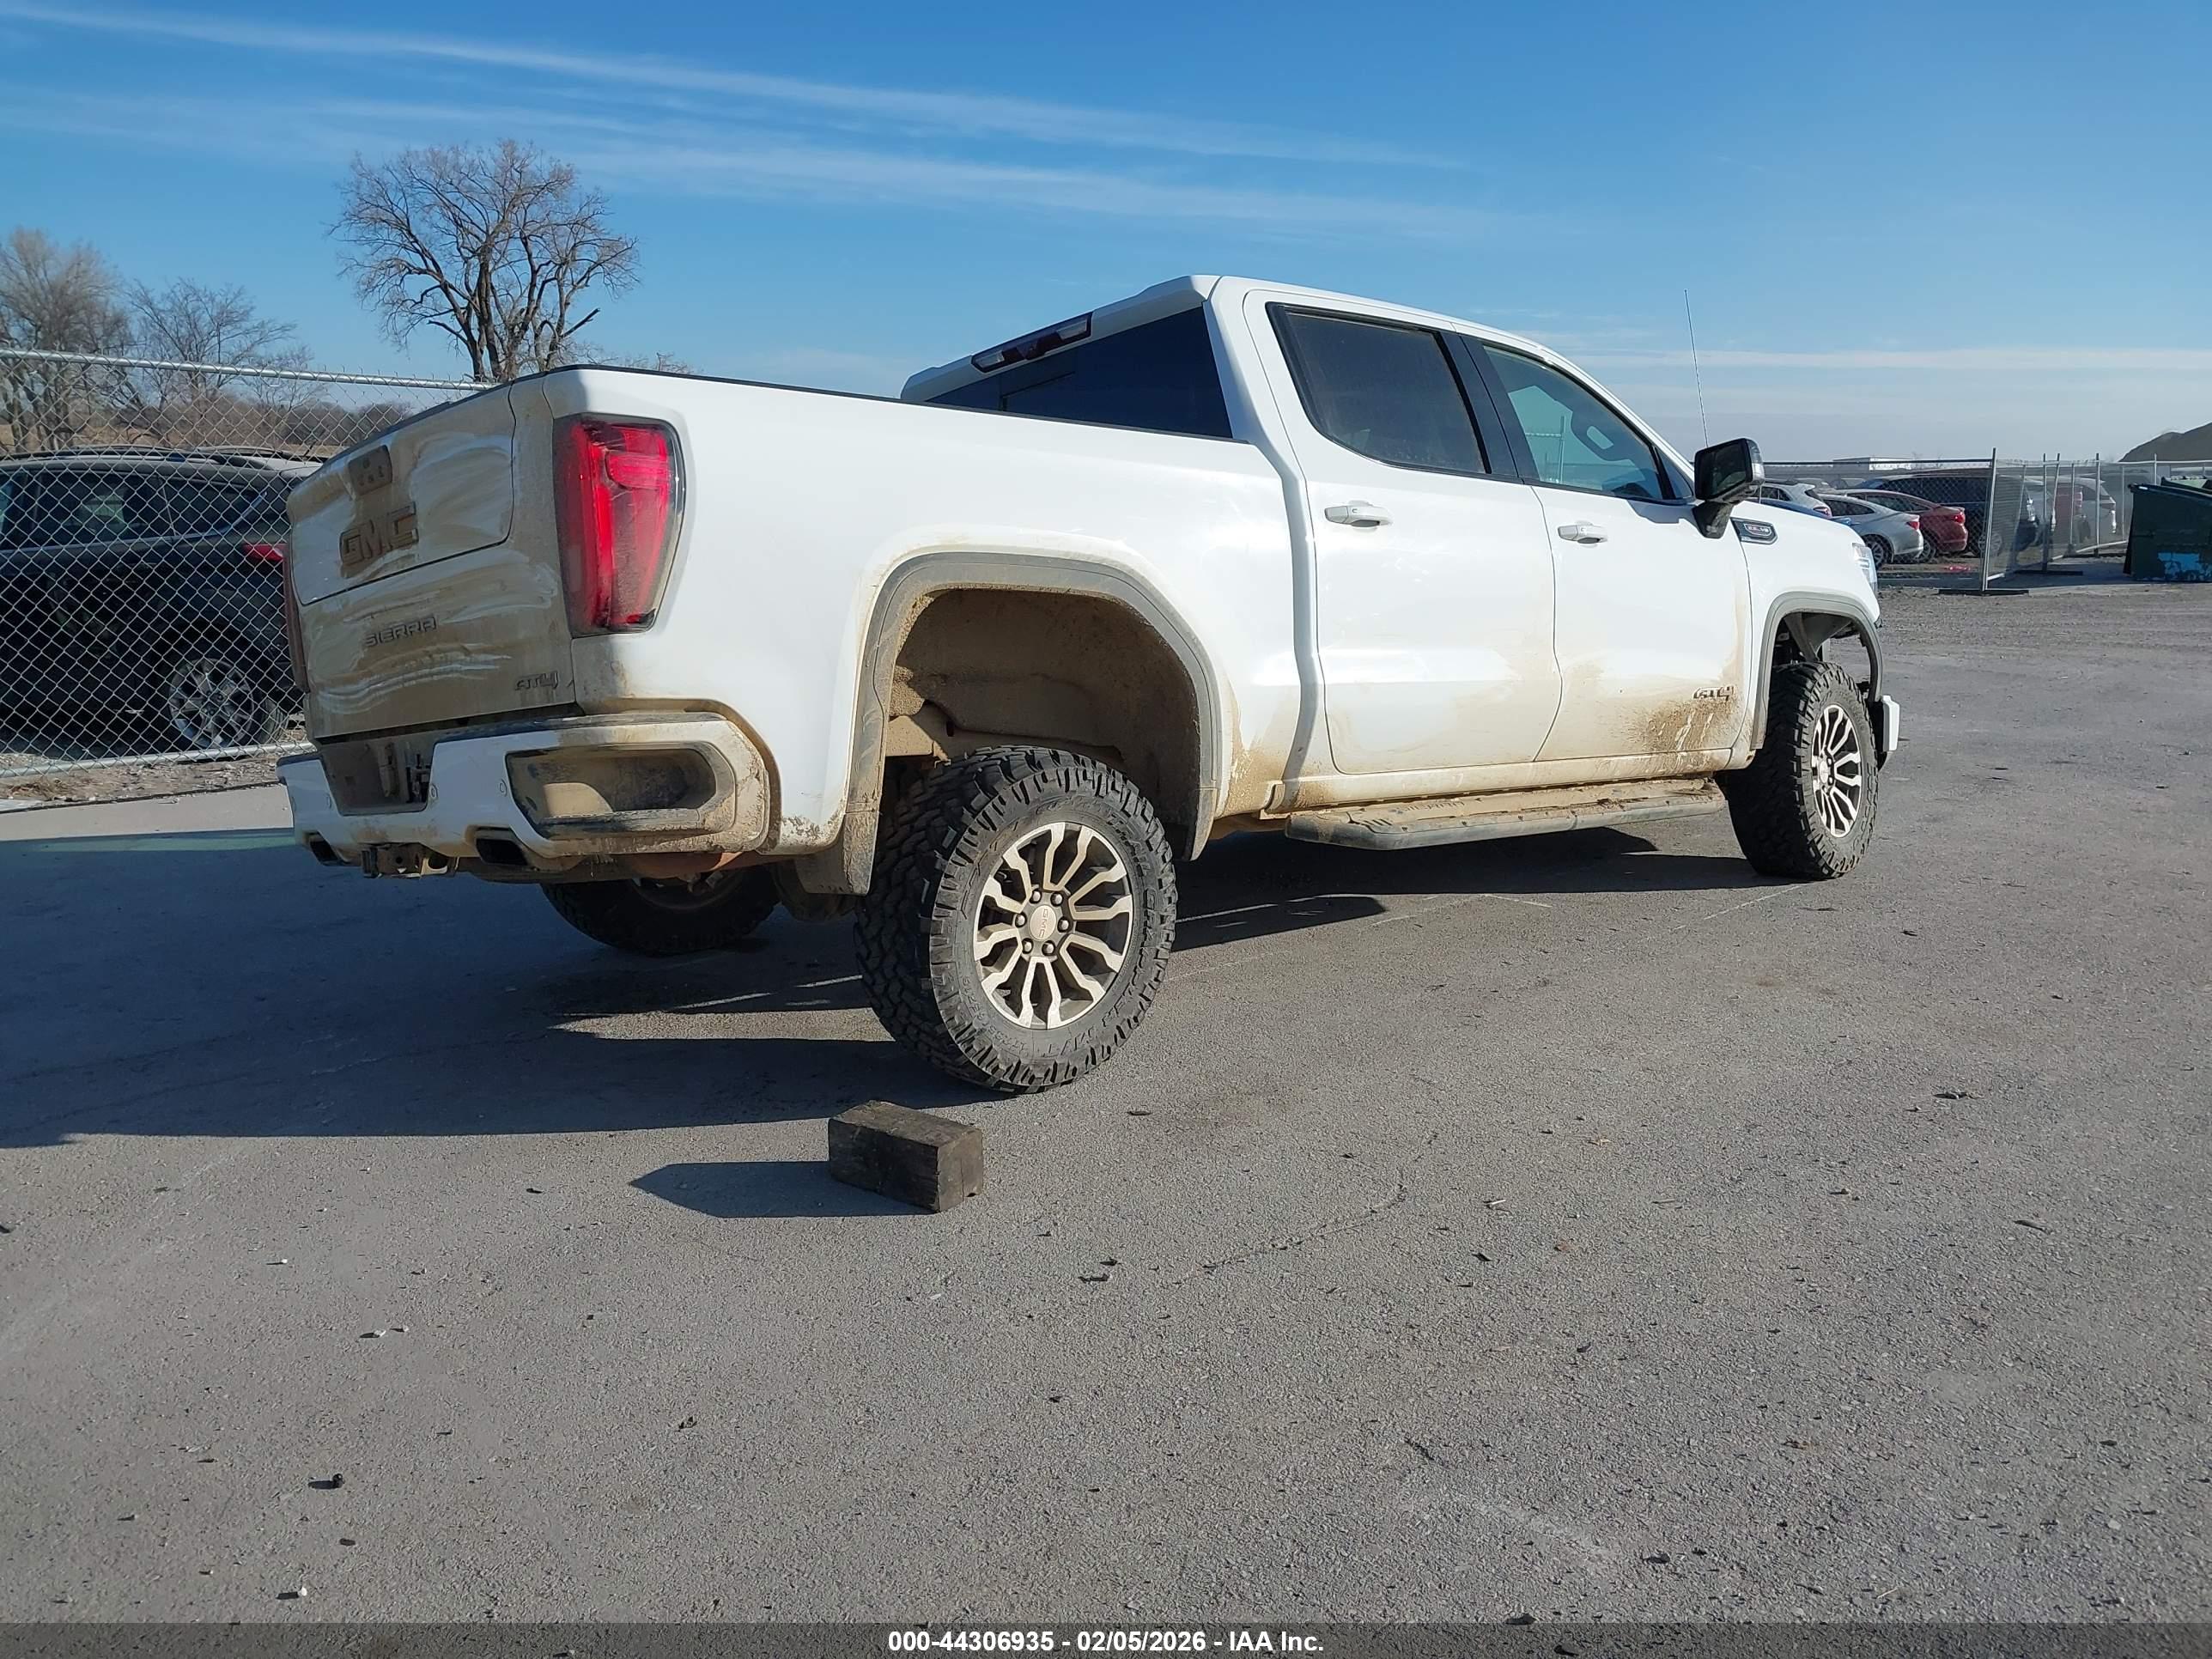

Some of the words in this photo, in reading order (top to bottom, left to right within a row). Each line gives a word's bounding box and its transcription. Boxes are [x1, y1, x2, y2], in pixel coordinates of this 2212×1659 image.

[339, 501, 419, 567] GMC
[364, 614, 438, 647] SIERRA
[515, 670, 558, 690] AT4
[1692, 685, 1735, 702] AT4
[1105, 810, 1152, 878] TRAIL
[1038, 908, 1048, 938] GMC
